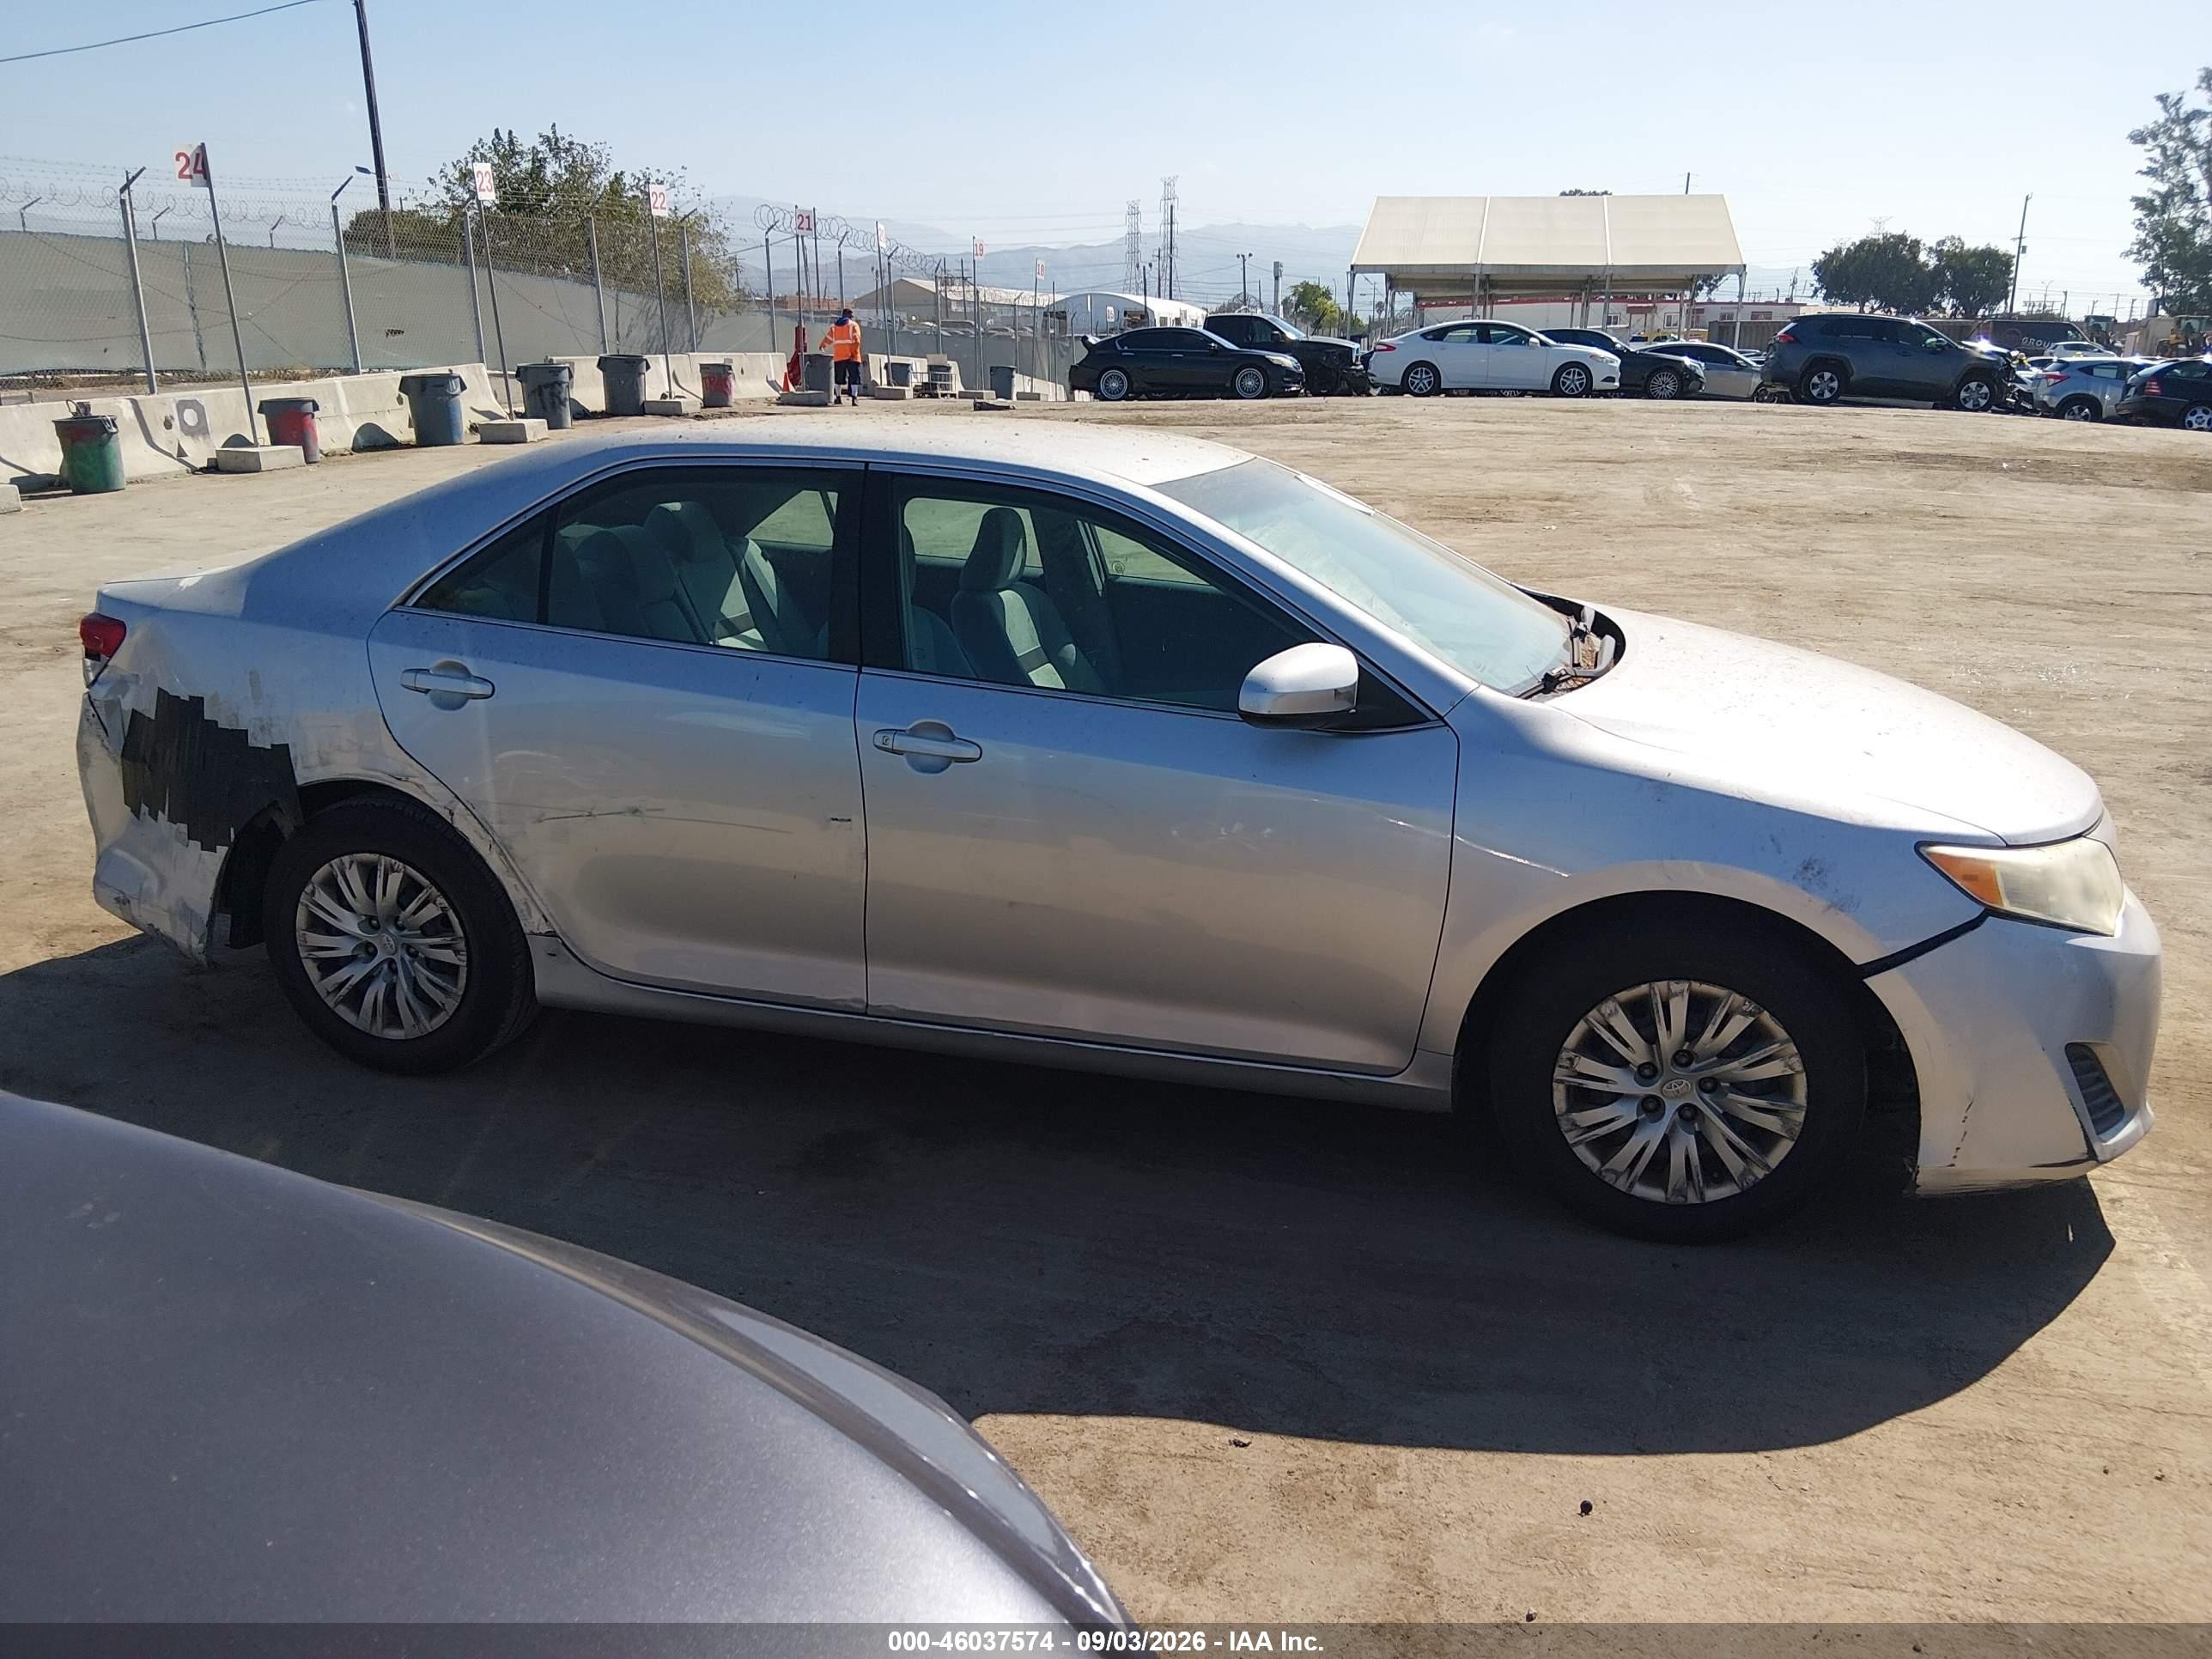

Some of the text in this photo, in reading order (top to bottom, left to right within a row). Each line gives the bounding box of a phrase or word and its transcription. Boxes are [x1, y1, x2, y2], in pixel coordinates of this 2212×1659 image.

[175, 152, 207, 179] 24
[477, 171, 493, 192] 23
[652, 191, 666, 210] 22
[797, 214, 812, 231] 21
[975, 243, 983, 256] 19
